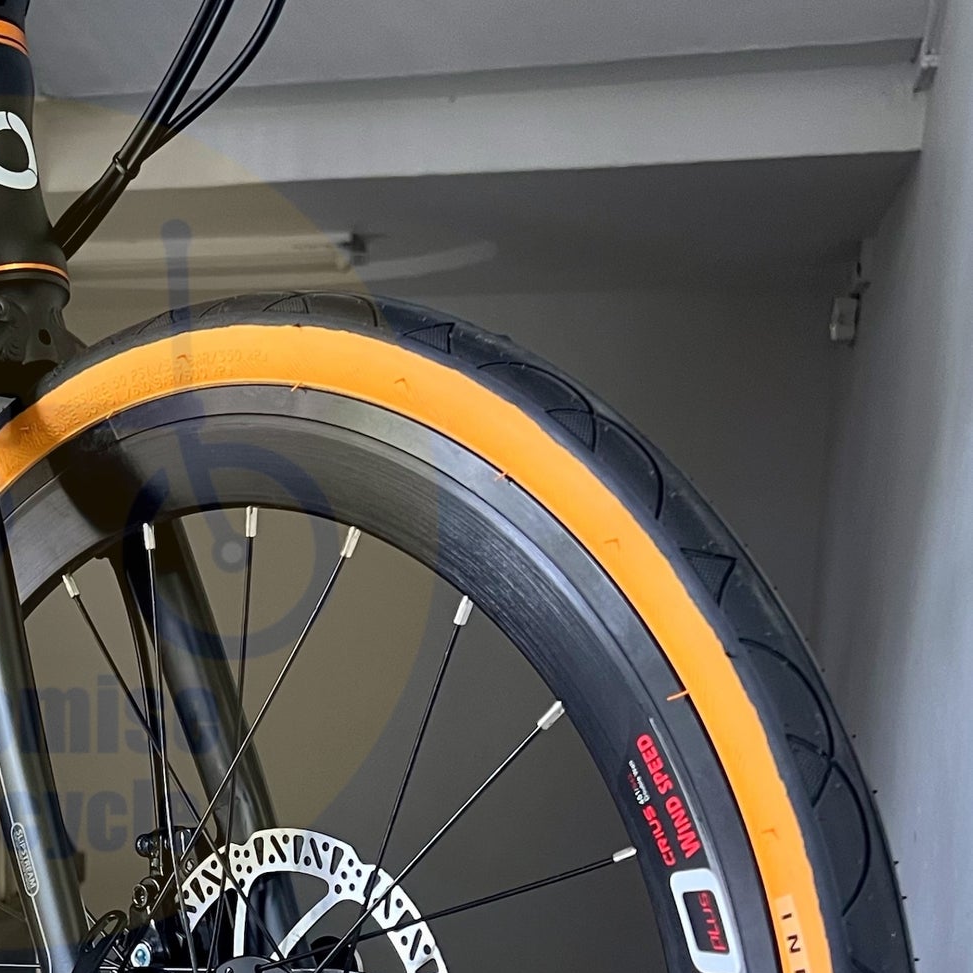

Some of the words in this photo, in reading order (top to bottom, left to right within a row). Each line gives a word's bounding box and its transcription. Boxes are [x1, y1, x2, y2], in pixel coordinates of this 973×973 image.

[637, 734, 673, 795] SPEED
[642, 805, 676, 866] CRIUS
[665, 795, 701, 859] WIND
